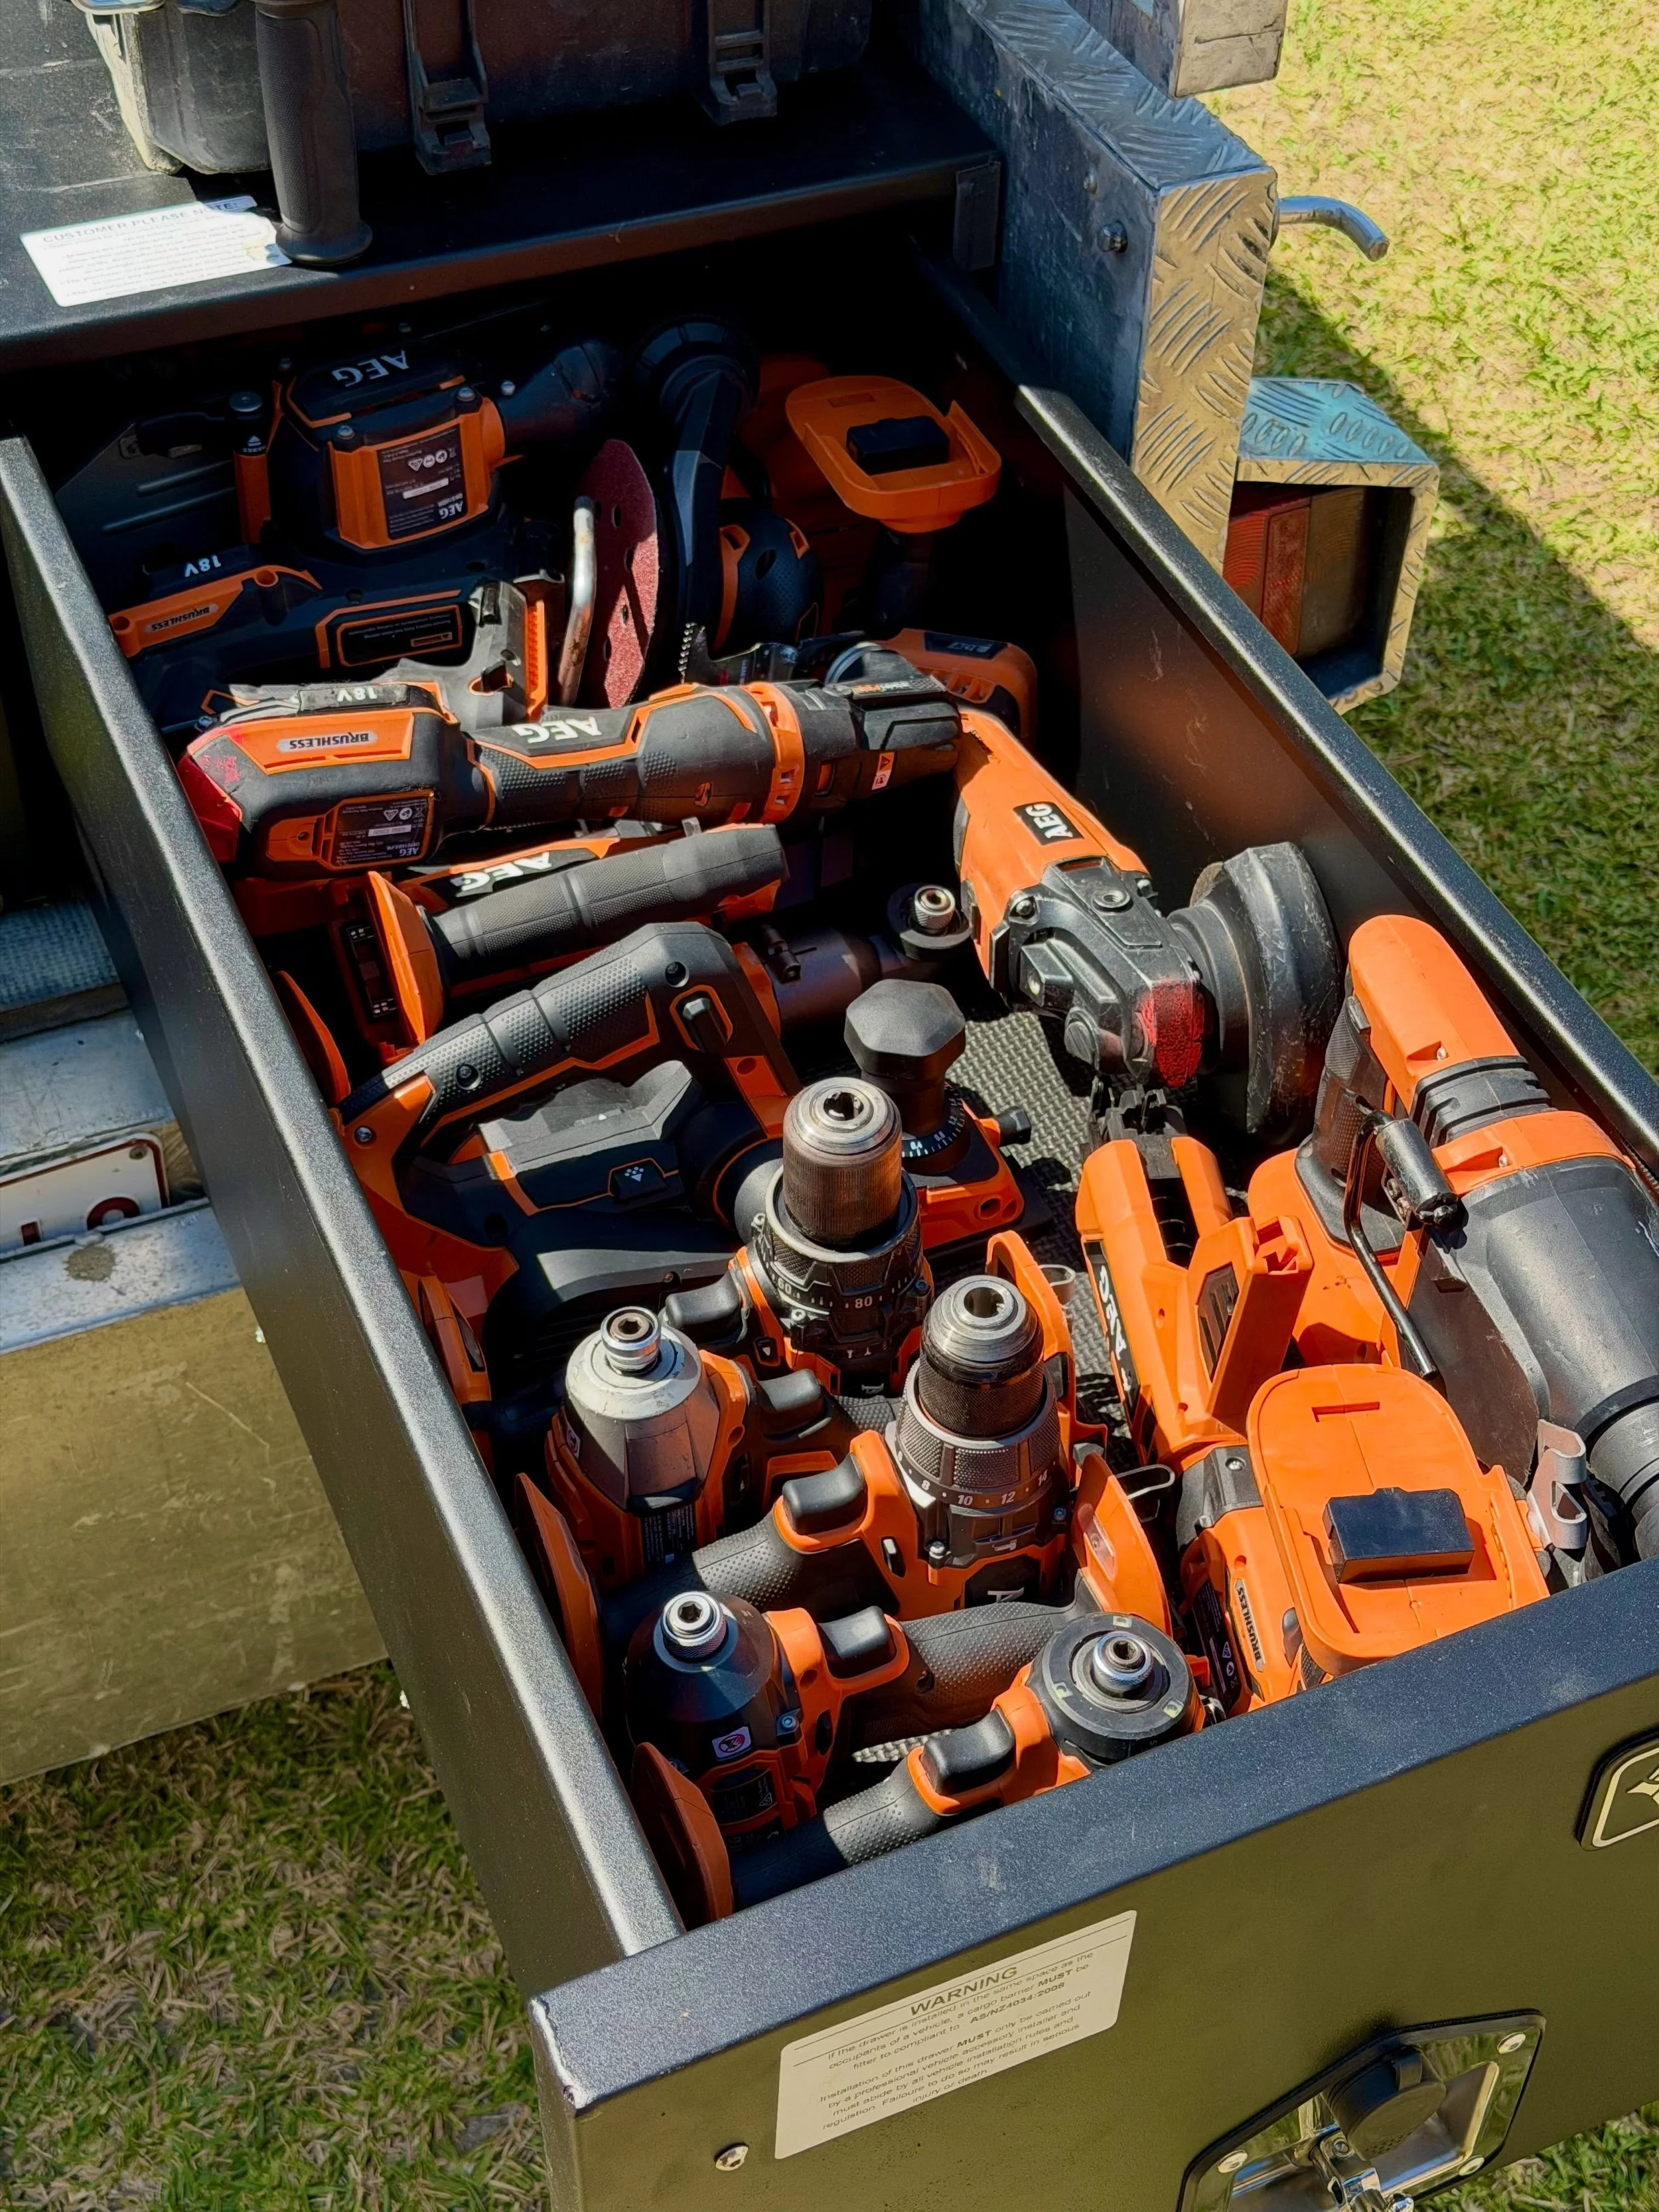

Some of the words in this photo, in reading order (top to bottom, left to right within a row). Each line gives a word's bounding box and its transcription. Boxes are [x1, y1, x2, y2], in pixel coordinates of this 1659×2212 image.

[41, 222, 129, 243] CUSTOMER
[130, 211, 188, 226] PLEASE
[332, 350, 409, 387] AEG
[438, 500, 463, 520] AEG
[184, 554, 222, 577] 18V
[151, 606, 210, 630] BRUSHLESS
[336, 686, 378, 702] 18V
[289, 732, 369, 749] BRUSHLESS
[512, 717, 603, 744] AEG
[1025, 803, 1073, 839] AEG
[399, 847, 420, 857] AEG
[450, 851, 552, 891] AEG
[778, 1279, 792, 1295] 60
[855, 1296, 873, 1308] 80
[1098, 1265, 1127, 1361] AEG
[921, 1480, 931, 1490] 8
[1038, 1470, 1048, 1486] 14
[958, 1495, 974, 1506] 10
[1001, 1491, 1016, 1505] 12
[1237, 1587, 1262, 1660] BRUSHLESS
[828, 2051, 836, 2061] If
[837, 2045, 856, 2057] the
[858, 2029, 897, 2048] drawer
[899, 2024, 908, 2033] is
[911, 2004, 957, 2028] installed
[960, 2000, 970, 2009] in
[972, 1992, 991, 2004] the
[992, 1979, 1023, 1996] same
[1025, 1965, 1059, 1982] space
[1060, 1959, 1074, 1969] as
[1076, 1952, 1094, 1963] the
[910, 1966, 1018, 2017] WARNING
[828, 2043, 887, 2070] occupants
[889, 2035, 901, 2047] of
[966, 1999, 998, 2016] cargo
[999, 1984, 1035, 2003] barrier
[1037, 1968, 1074, 1988] MUST
[1075, 1963, 1090, 1973] be
[819, 2075, 879, 2103] Installation
[881, 2067, 893, 2079] of
[894, 2061, 914, 2074] this
[916, 2044, 955, 2064] drawer
[956, 2029, 993, 2049] MUST
[994, 2020, 1017, 2033] only
[1019, 2014, 1034, 2024] be
[1035, 1997, 1072, 2018] carried
[1073, 1990, 1092, 2002] out
[828, 2099, 842, 2109] by
[853, 2067, 920, 2101] professional
[921, 2053, 960, 2071] vehicle
[961, 2030, 1015, 2056] accessory
[1017, 2013, 1059, 2033] installer
[1060, 2003, 1082, 2018] and
[879, 2051, 893, 2060] to
[893, 2028, 947, 2055] compliant
[949, 2024, 960, 2033] to
[927, 2079, 939, 2088] to
[940, 2073, 956, 2083] do
[957, 2067, 972, 2077] so
[973, 2056, 997, 2071] may
[997, 2043, 1028, 2060] result
[1029, 2039, 1041, 2048] in
[1042, 2023, 1080, 2043] serious
[832, 2101, 861, 2117] must
[862, 2088, 894, 2105] abide
[895, 2081, 909, 2092] by
[910, 2075, 924, 2086] all
[926, 2060, 964, 2079] vehicle
[966, 2037, 1023, 2063] installation
[1025, 2026, 1052, 2040] rules
[1052, 2015, 1074, 2029] and
[912, 2087, 942, 2104] injury
[943, 2081, 956, 2091] or
[957, 2069, 988, 2085] death
